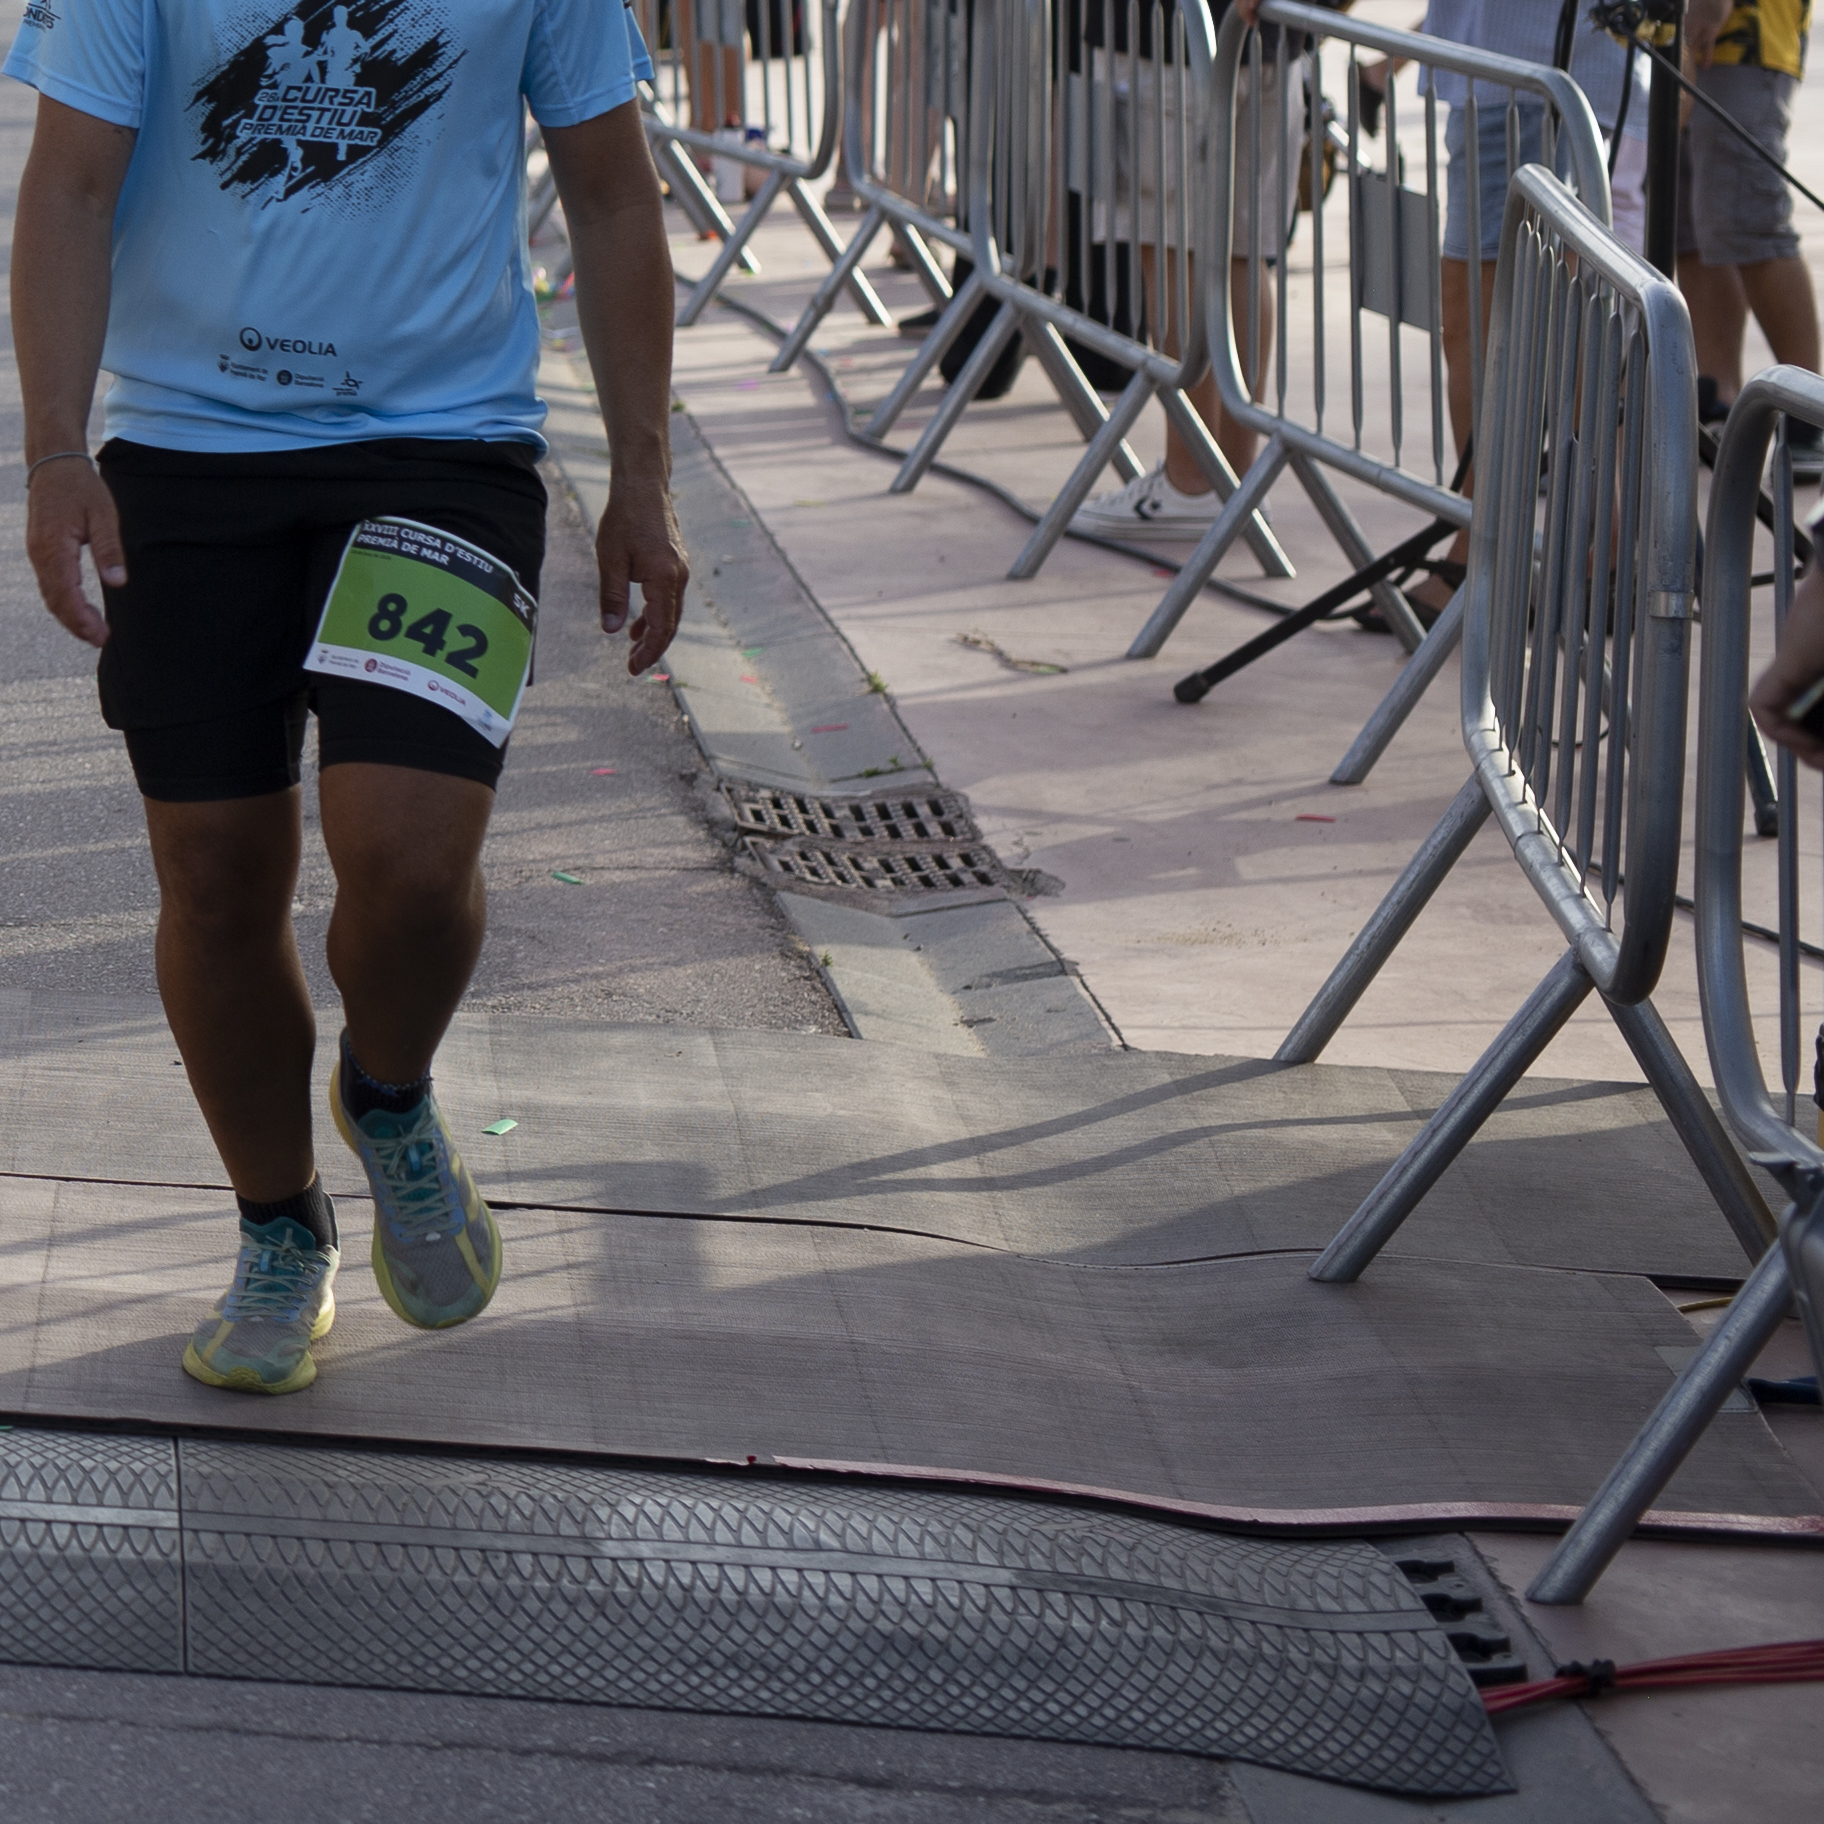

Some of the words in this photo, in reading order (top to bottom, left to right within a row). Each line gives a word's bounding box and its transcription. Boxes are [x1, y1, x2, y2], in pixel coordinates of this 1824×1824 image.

[280, 85, 374, 110] CURSA
[256, 104, 359, 127] D'ESTIU
[309, 126, 337, 140] DE
[335, 128, 380, 143] MAR
[266, 336, 338, 357] VEOLIA
[400, 528, 442, 549] CURSA
[400, 542, 420, 555] DE
[420, 547, 451, 566] MAR
[513, 592, 531, 618] 5K
[367, 592, 490, 680] 842
